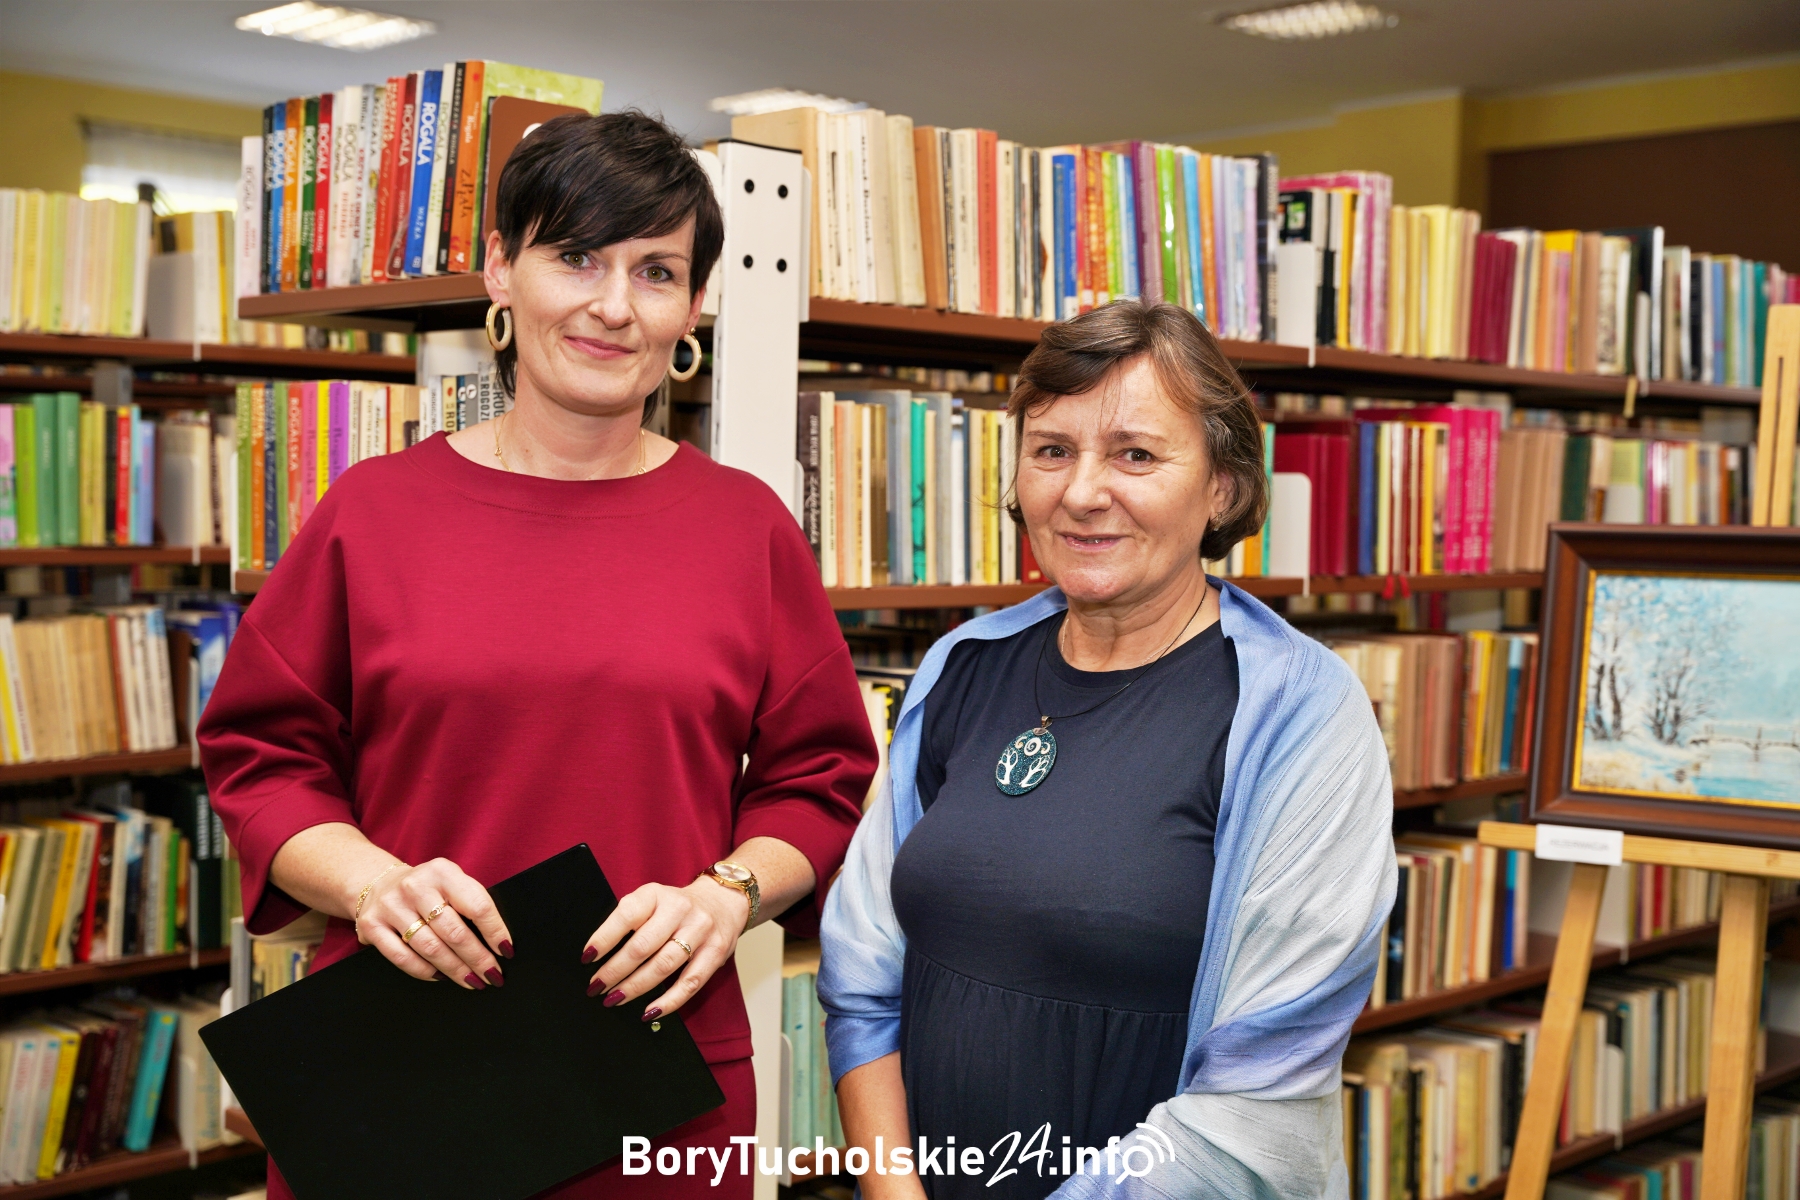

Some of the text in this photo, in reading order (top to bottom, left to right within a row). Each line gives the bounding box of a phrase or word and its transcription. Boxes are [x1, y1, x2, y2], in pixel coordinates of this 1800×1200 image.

[272, 130, 285, 189] ROGALA
[285, 127, 298, 187] ROGALA
[302, 125, 315, 185] ROGALA
[315, 123, 330, 183] ROGALA
[342, 123, 357, 183] ROGALA
[398, 103, 414, 167] ROGALA
[416, 102, 437, 166] ROGALA
[434, 102, 449, 163] ROGALA
[445, 411, 456, 432] RO
[480, 383, 490, 422] ROGOZI
[288, 397, 300, 472] ROGALSKA
